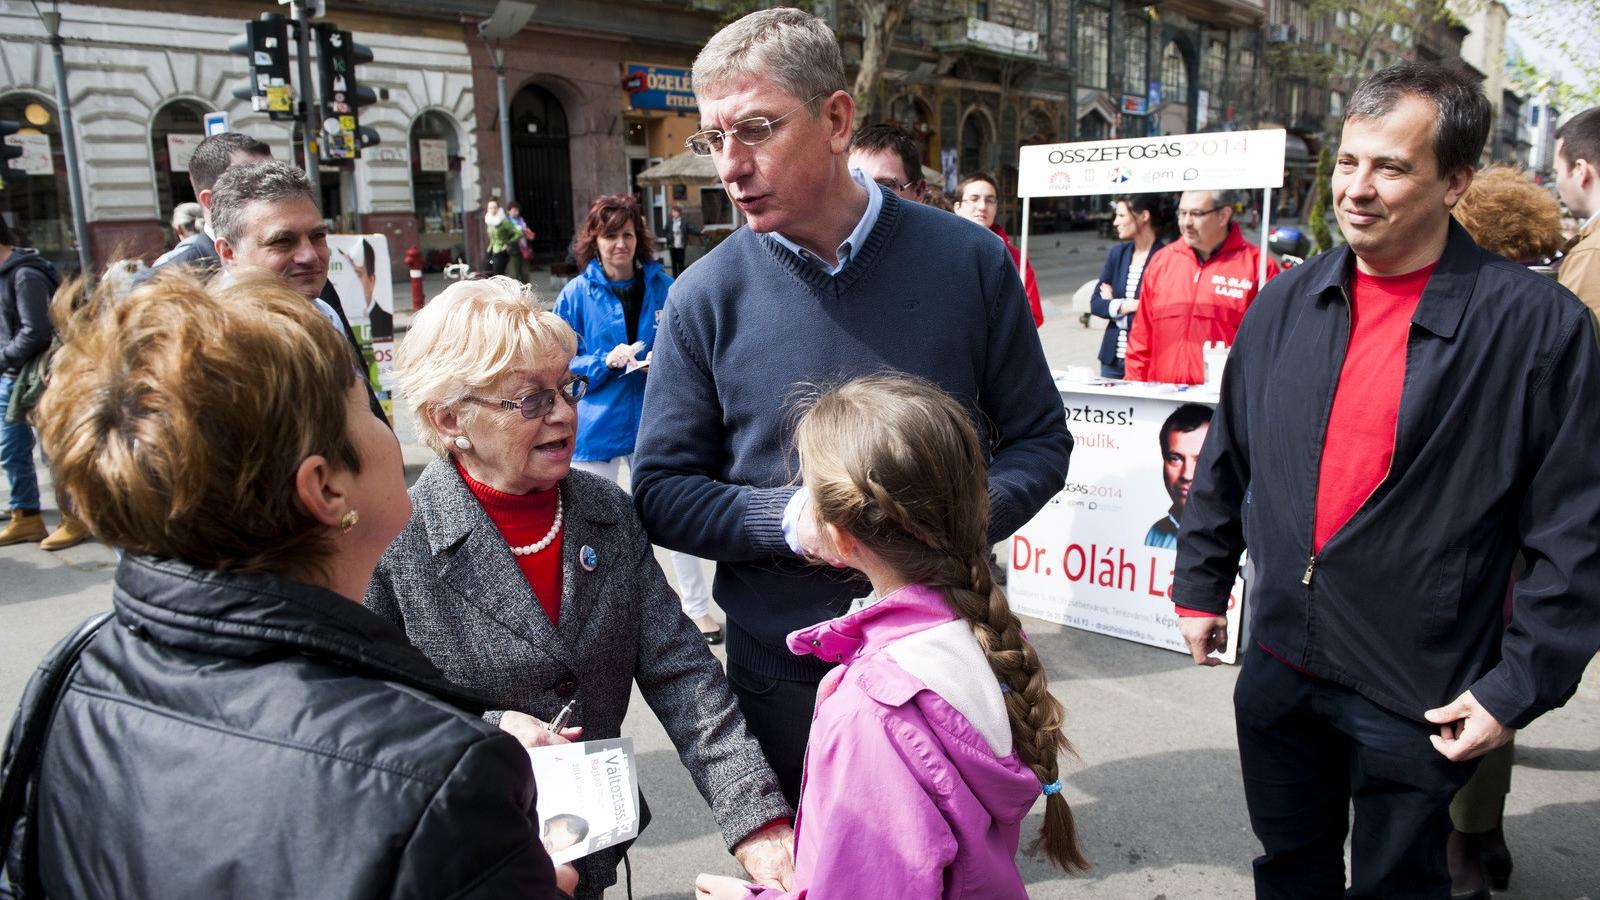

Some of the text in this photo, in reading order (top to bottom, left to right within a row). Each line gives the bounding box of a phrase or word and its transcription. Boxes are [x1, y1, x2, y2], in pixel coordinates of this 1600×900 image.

[1089, 484, 1122, 498] 2014
[1012, 535, 1051, 576] Dr.
[1063, 543, 1136, 591] Oláh
